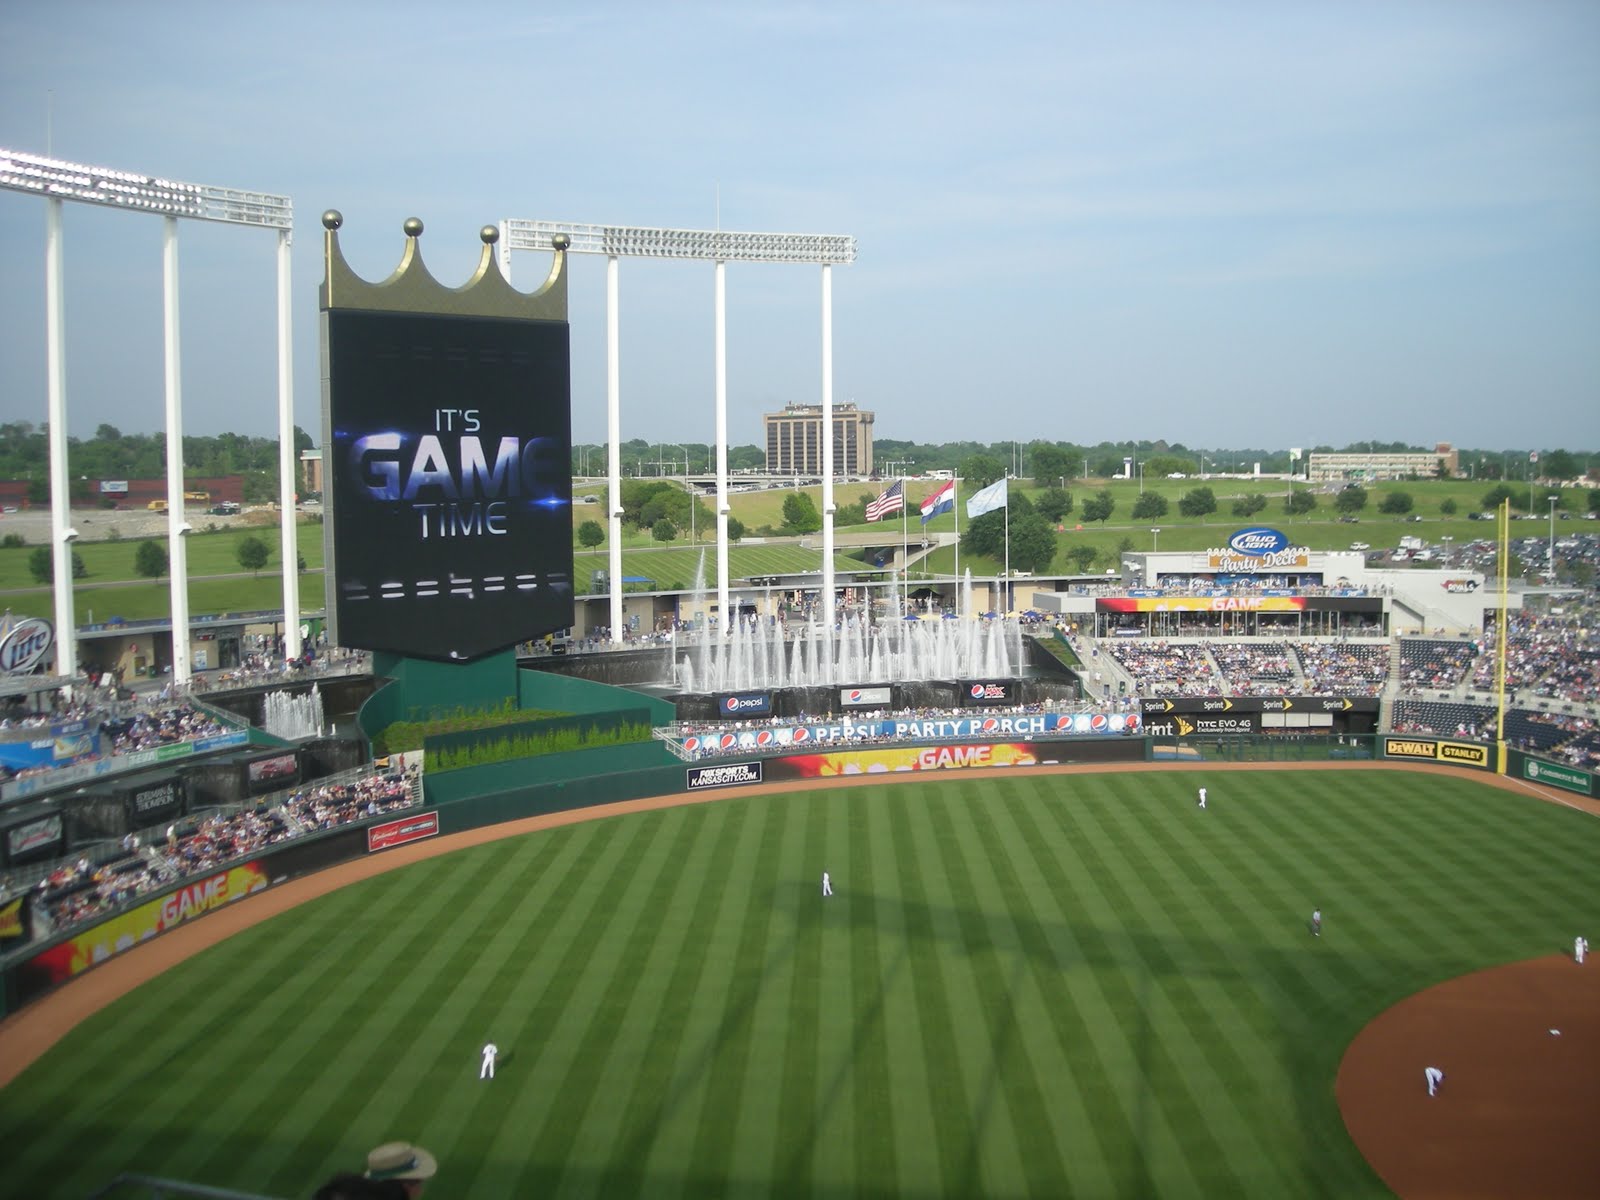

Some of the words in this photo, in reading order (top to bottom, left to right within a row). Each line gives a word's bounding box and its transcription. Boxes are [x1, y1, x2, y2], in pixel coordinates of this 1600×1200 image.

[435, 409, 481, 432] IT'S
[353, 431, 557, 501] GAME
[412, 501, 508, 539] TIME
[1240, 541, 1279, 549] LIGHT
[1218, 555, 1260, 575] Party
[1262, 551, 1298, 568] Deck
[1212, 597, 1264, 610] GAME
[739, 698, 763, 709] pepsi
[1145, 702, 1165, 712] Sprint
[1204, 701, 1224, 711] Sprint
[1263, 701, 1283, 711] Sprint
[1323, 701, 1344, 711] Sprint
[816, 724, 876, 742] PEPSI
[896, 720, 963, 738] PARTY
[970, 717, 1045, 734] PORCH
[1218, 720, 1237, 728] EVO
[1238, 719, 1251, 728] 4G
[918, 746, 990, 769] GAME
[1444, 743, 1481, 760] STANLEY
[1539, 767, 1572, 781] Commerce
[1572, 774, 1588, 786] Bank
[161, 875, 227, 925] GAME
